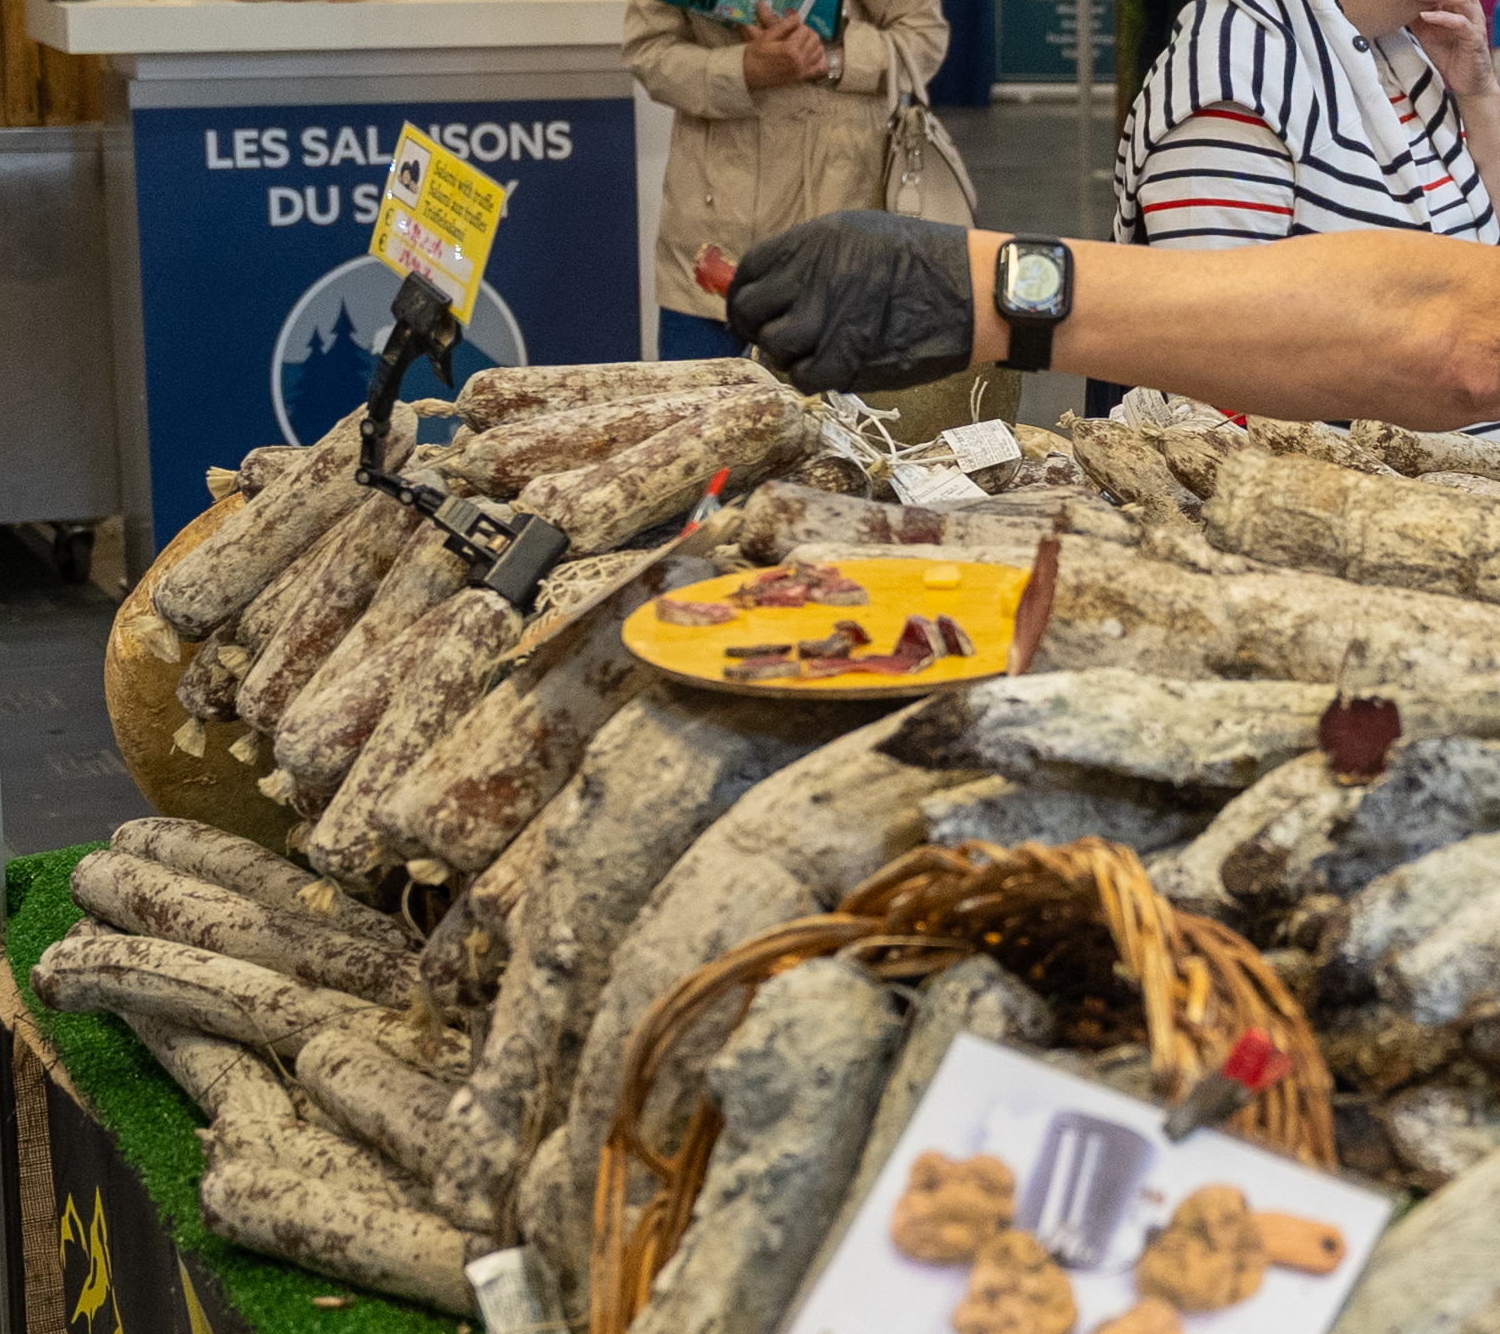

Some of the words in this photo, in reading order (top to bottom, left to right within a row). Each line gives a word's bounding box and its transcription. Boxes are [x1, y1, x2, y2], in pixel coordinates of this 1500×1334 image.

[205, 127, 290, 170] LES
[300, 120, 574, 168] SALISONS
[267, 183, 341, 227] DU
